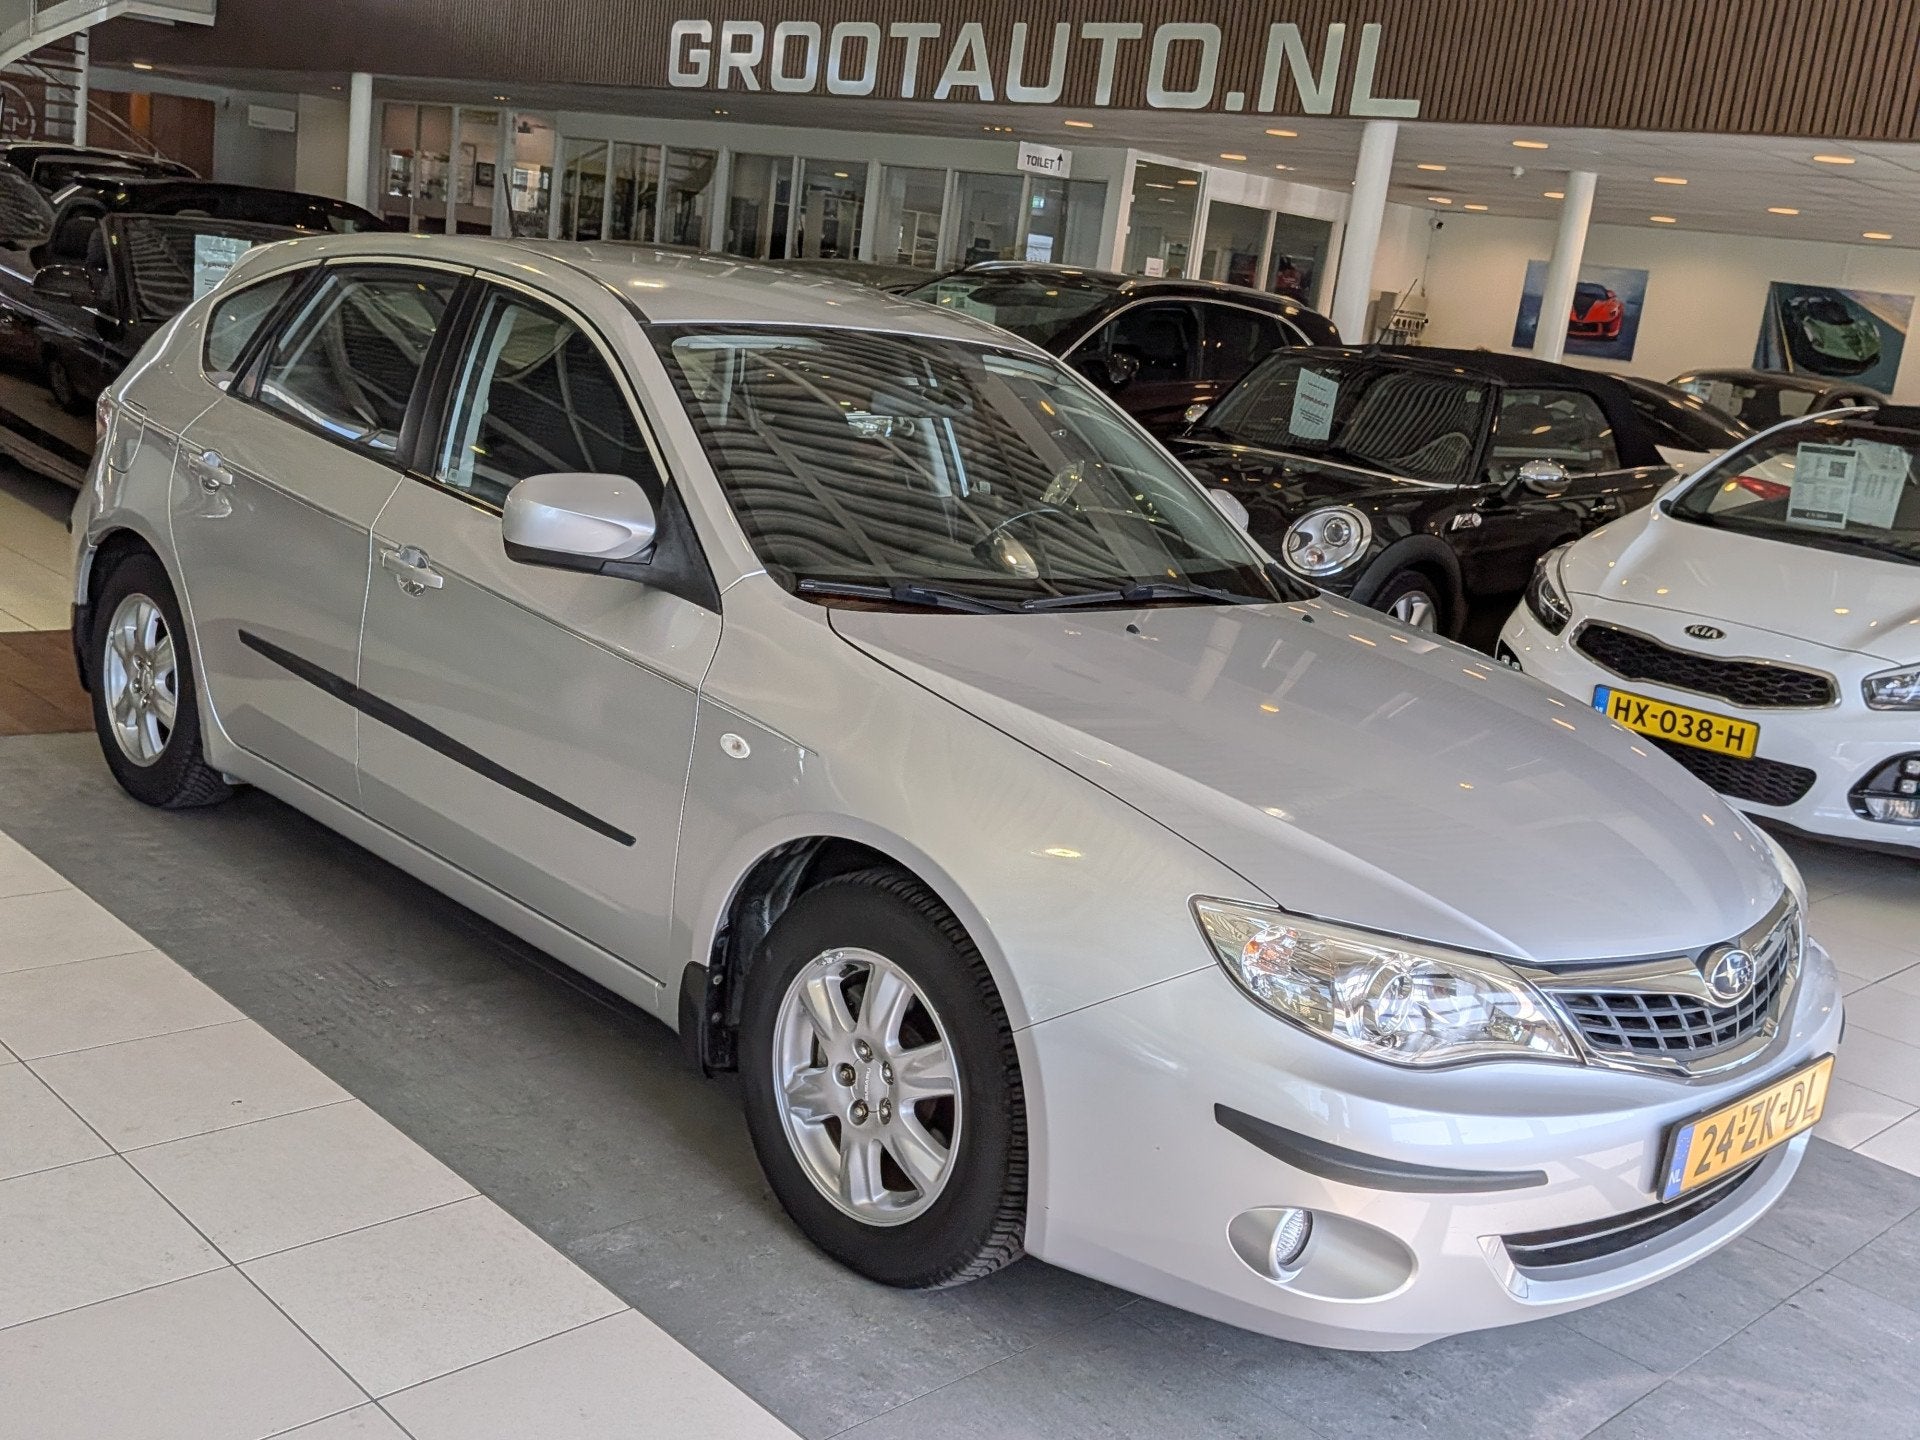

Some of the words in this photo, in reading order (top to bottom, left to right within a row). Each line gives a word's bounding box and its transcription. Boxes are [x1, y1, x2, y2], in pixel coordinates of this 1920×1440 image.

[668, 19, 1421, 118] GROOTAUTO.NL
[1026, 154, 1055, 170] TOILET
[1689, 624, 1719, 640] KIA
[1613, 697, 1746, 752] HX-038-H
[1693, 1072, 1817, 1178] 24-ZK-DL
[1667, 1168, 1682, 1187] NL
